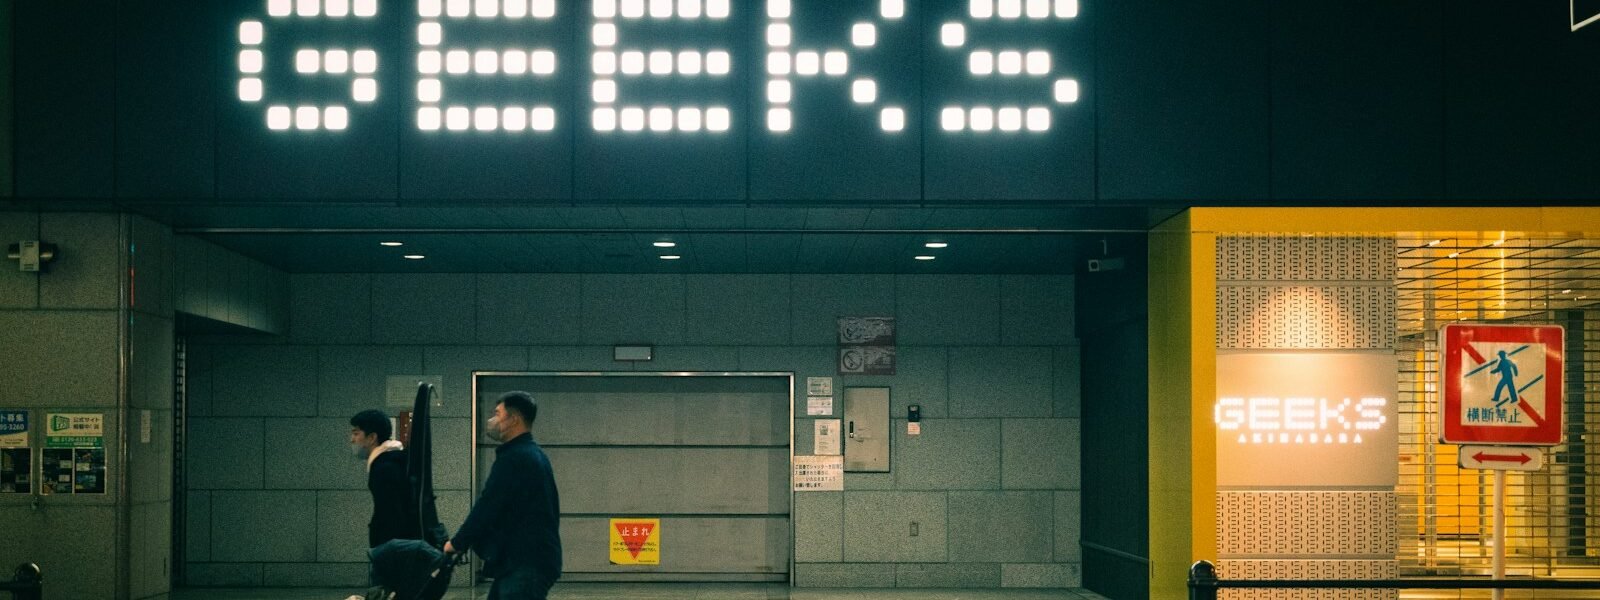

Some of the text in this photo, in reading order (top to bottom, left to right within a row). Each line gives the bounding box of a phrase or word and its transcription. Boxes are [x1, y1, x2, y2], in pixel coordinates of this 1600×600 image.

[238, 0, 1079, 132] GEEKS
[1215, 398, 1386, 429] GEEKS
[1467, 407, 1522, 423] 横断禁止
[622, 526, 650, 537] 止まれ
